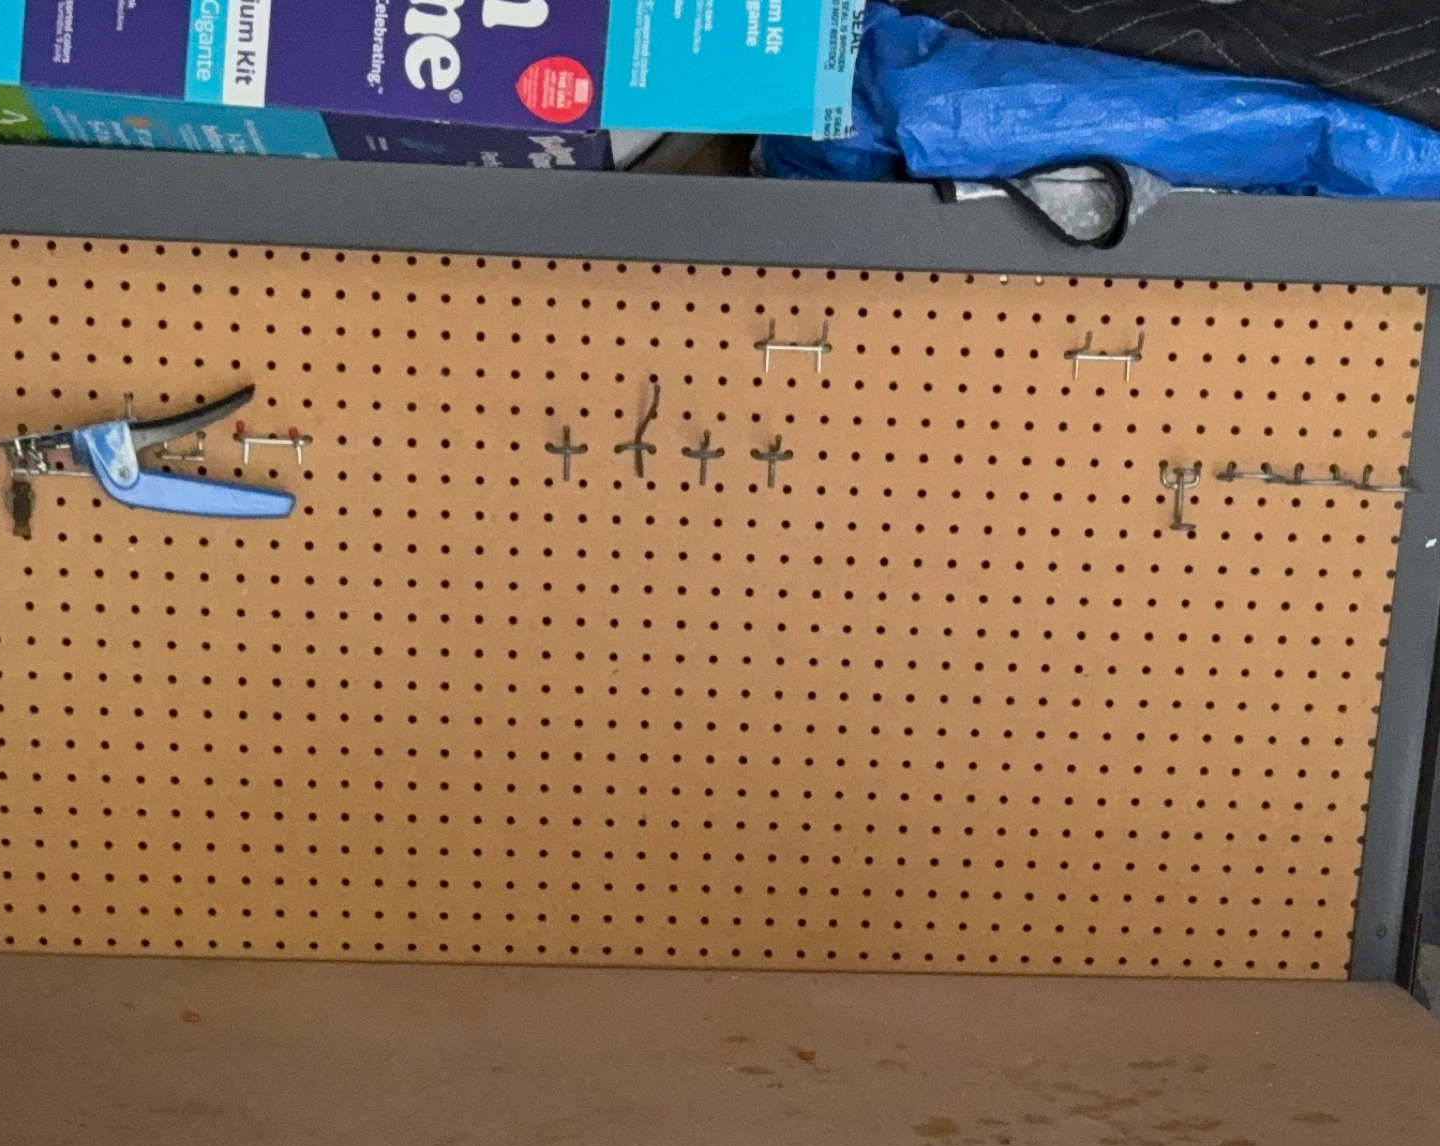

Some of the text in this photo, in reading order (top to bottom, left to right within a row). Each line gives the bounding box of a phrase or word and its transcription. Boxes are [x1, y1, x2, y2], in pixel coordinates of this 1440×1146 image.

[62, 33, 72, 63] colors
[765, 27, 783, 54] Kit
[828, 29, 838, 70] RESTOCK
[838, 35, 848, 72] BROKEN
[235, 50, 256, 86] Kit
